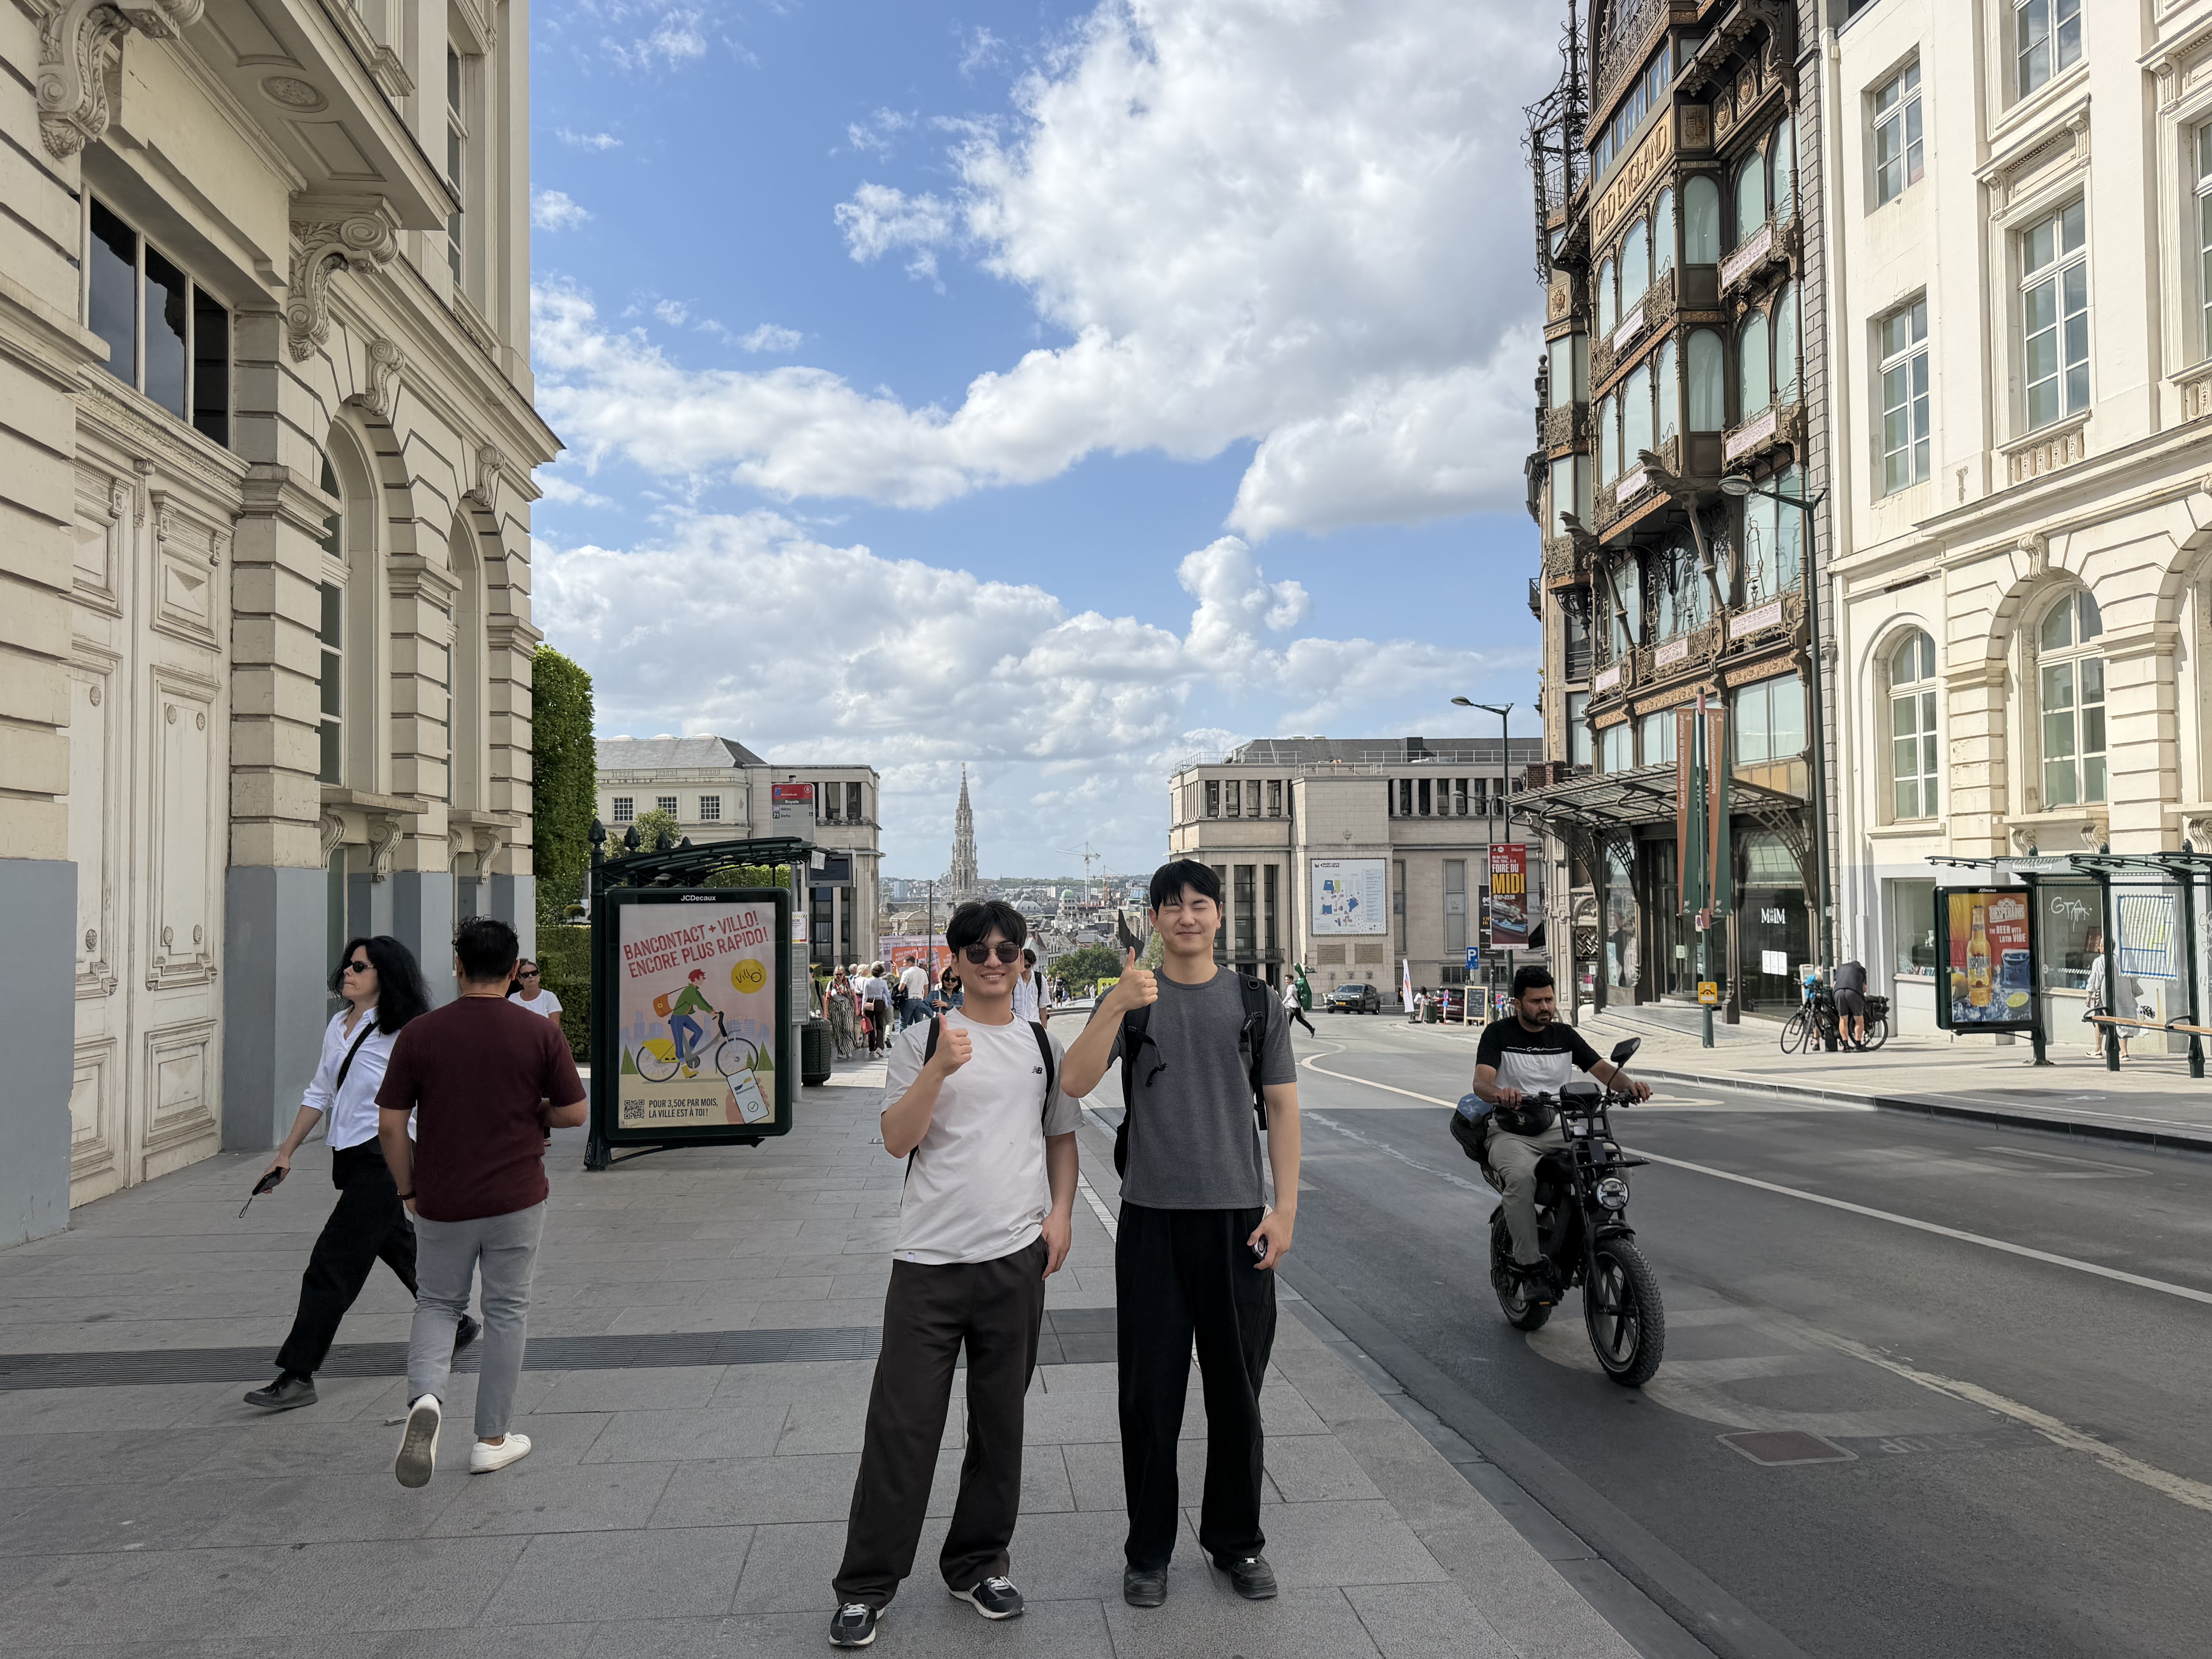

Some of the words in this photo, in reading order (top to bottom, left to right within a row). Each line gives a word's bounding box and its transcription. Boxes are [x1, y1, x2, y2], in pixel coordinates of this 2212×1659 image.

[1594, 192, 1616, 237] OLD
[1618, 124, 1667, 211] ENGLAND
[1492, 864, 1509, 873] FOIRE
[1510, 864, 1519, 872] DU
[2012, 862, 2030, 871] Royale
[2034, 862, 2052, 870] Koning
[1492, 873, 1525, 894] MIDI
[1990, 905, 2025, 921] DESPERADOS
[623, 924, 705, 960] BANCONTACT
[717, 910, 759, 934] VILLO!
[1996, 926, 2010, 934] BEER
[2013, 933, 2026, 943] VIBE
[629, 951, 680, 978] ENCORE
[681, 942, 715, 963] PLUS
[716, 926, 769, 954] RAPIDO!
[1468, 949, 1476, 961] P
[736, 1085, 755, 1095] Bancontact
[649, 1100, 666, 1108] POUR
[667, 1099, 686, 1108] 3,50€
[687, 1099, 699, 1107] PAR
[701, 1098, 718, 1107] MOIS,
[649, 1110, 657, 1118] LA
[658, 1109, 675, 1118] VILLE
[677, 1109, 688, 1117] EST
[689, 1107, 694, 1117] À
